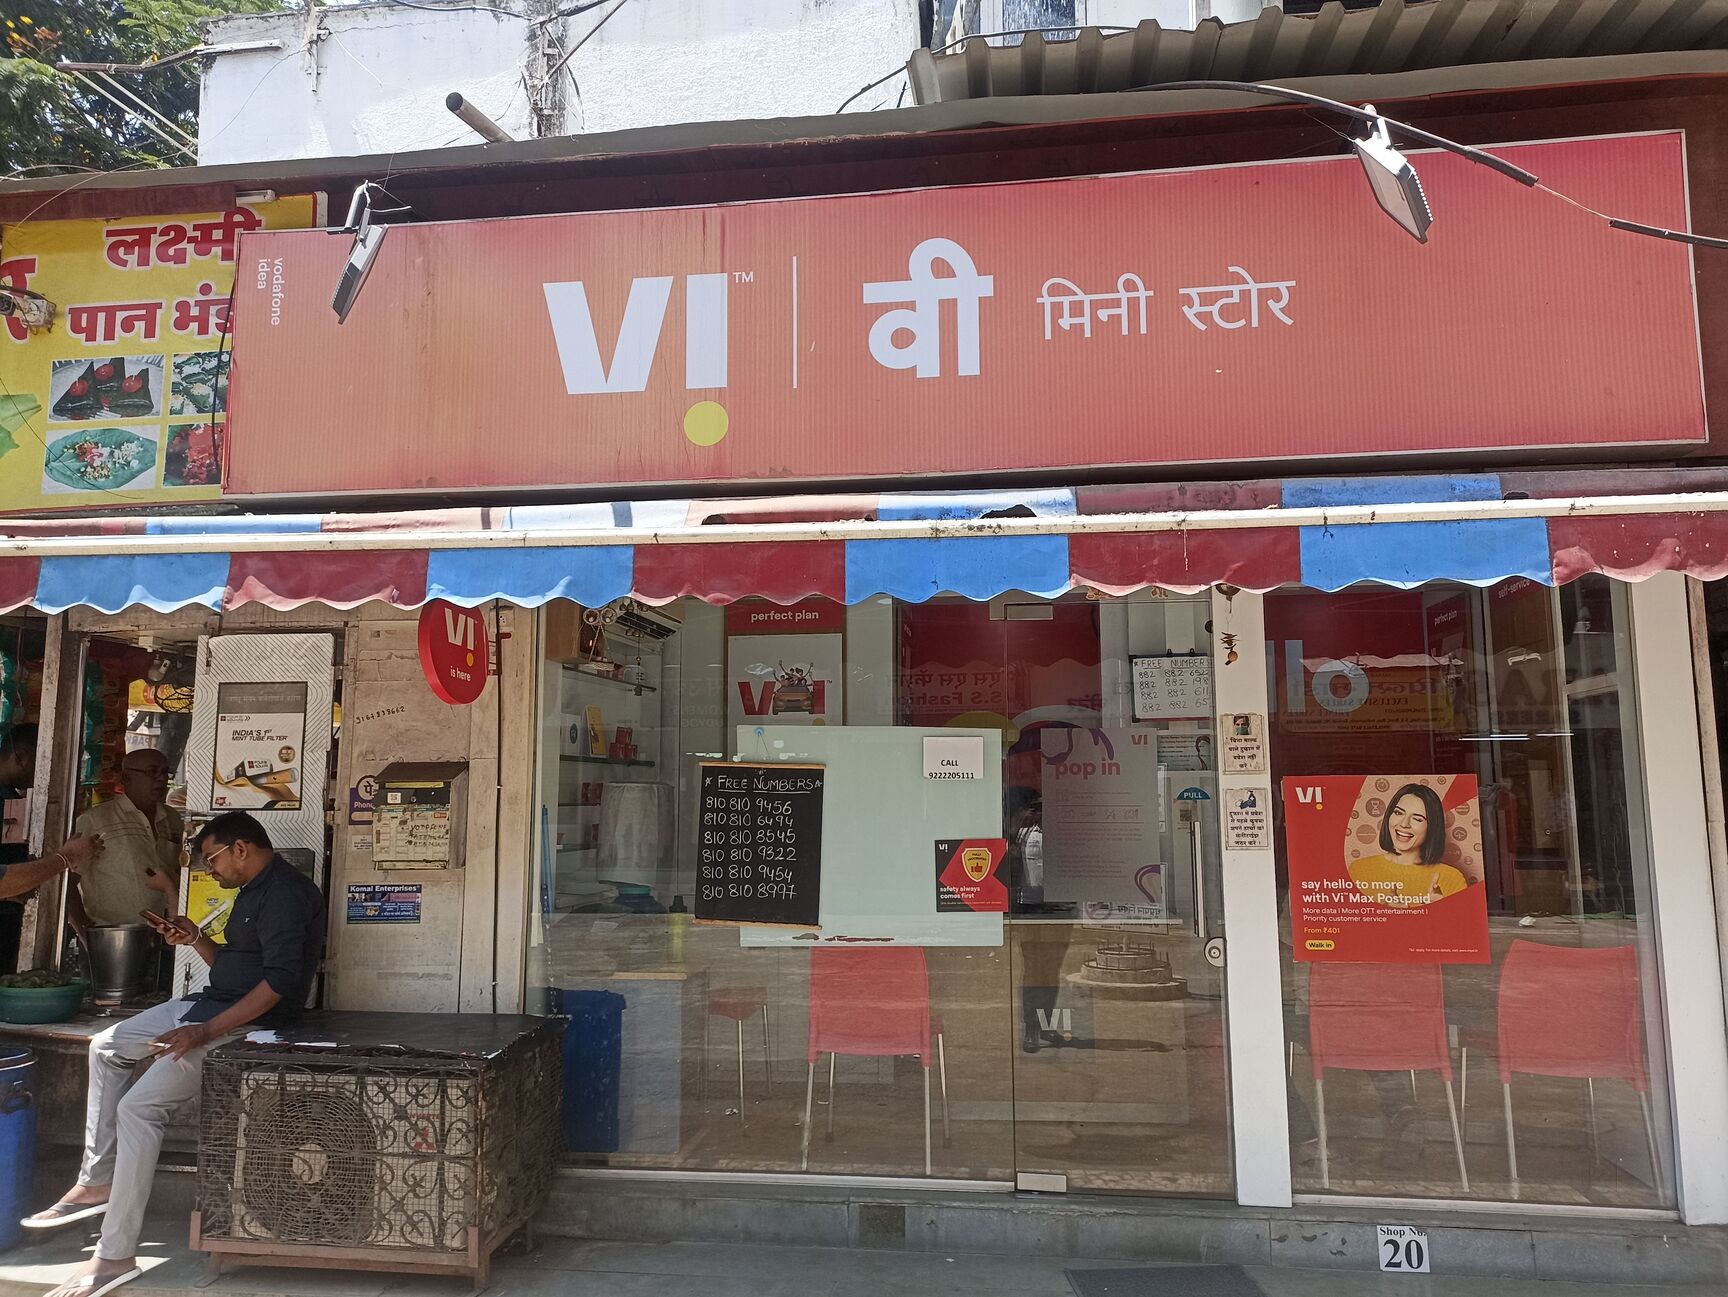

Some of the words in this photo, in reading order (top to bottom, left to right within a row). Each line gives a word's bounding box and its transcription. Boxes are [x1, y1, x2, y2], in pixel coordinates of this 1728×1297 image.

[257, 258, 271, 289] idea
[270, 257, 285, 326] vodafone
[862, 237, 994, 378] वी
[1036, 272, 1154, 340] मिनी
[1178, 266, 1297, 330] स्टोर
[68, 302, 163, 342] पान
[174, 282, 233, 336] भंड
[751, 610, 793, 623] perfect
[795, 610, 819, 622] plan
[450, 666, 456, 678] is
[457, 667, 471, 682] here
[1139, 671, 1155, 679] 882
[1164, 669, 1184, 677] 882
[1140, 681, 1156, 690] 882
[1141, 692, 1159, 700] 882
[1168, 689, 1186, 697] 882
[1142, 703, 1161, 713] 882
[1169, 701, 1188, 709] 882
[941, 759, 959, 767] CALL
[1055, 760, 1096, 780] pop
[1102, 757, 1121, 776] in
[718, 775, 748, 789] FREE
[753, 776, 813, 791] NUMBERS
[706, 796, 726, 809] 810
[729, 797, 750, 811] 810
[756, 798, 792, 814] 9456
[704, 813, 726, 825] 810
[729, 813, 751, 826] 810
[757, 815, 793, 827] 6494
[704, 831, 725, 844] 810
[730, 830, 751, 845] 810
[756, 829, 796, 843] 8545
[702, 849, 725, 862] 810
[730, 848, 752, 862] 810
[758, 846, 797, 861] 9322
[702, 866, 723, 879] 810
[729, 865, 752, 879] 810
[758, 865, 792, 882] 9454
[702, 885, 724, 900] 810
[729, 884, 752, 897] 810
[757, 883, 797, 899] 8997
[1301, 881, 1321, 891] say
[1323, 879, 1353, 889] hello
[1356, 880, 1369, 889] to
[1371, 881, 1404, 889] more
[1302, 892, 1329, 903] with
[1349, 893, 1375, 903] Max
[1377, 893, 1431, 905] Postpaid
[1380, 1227, 1405, 1238] Shop
[1383, 1239, 1424, 1269] 20
